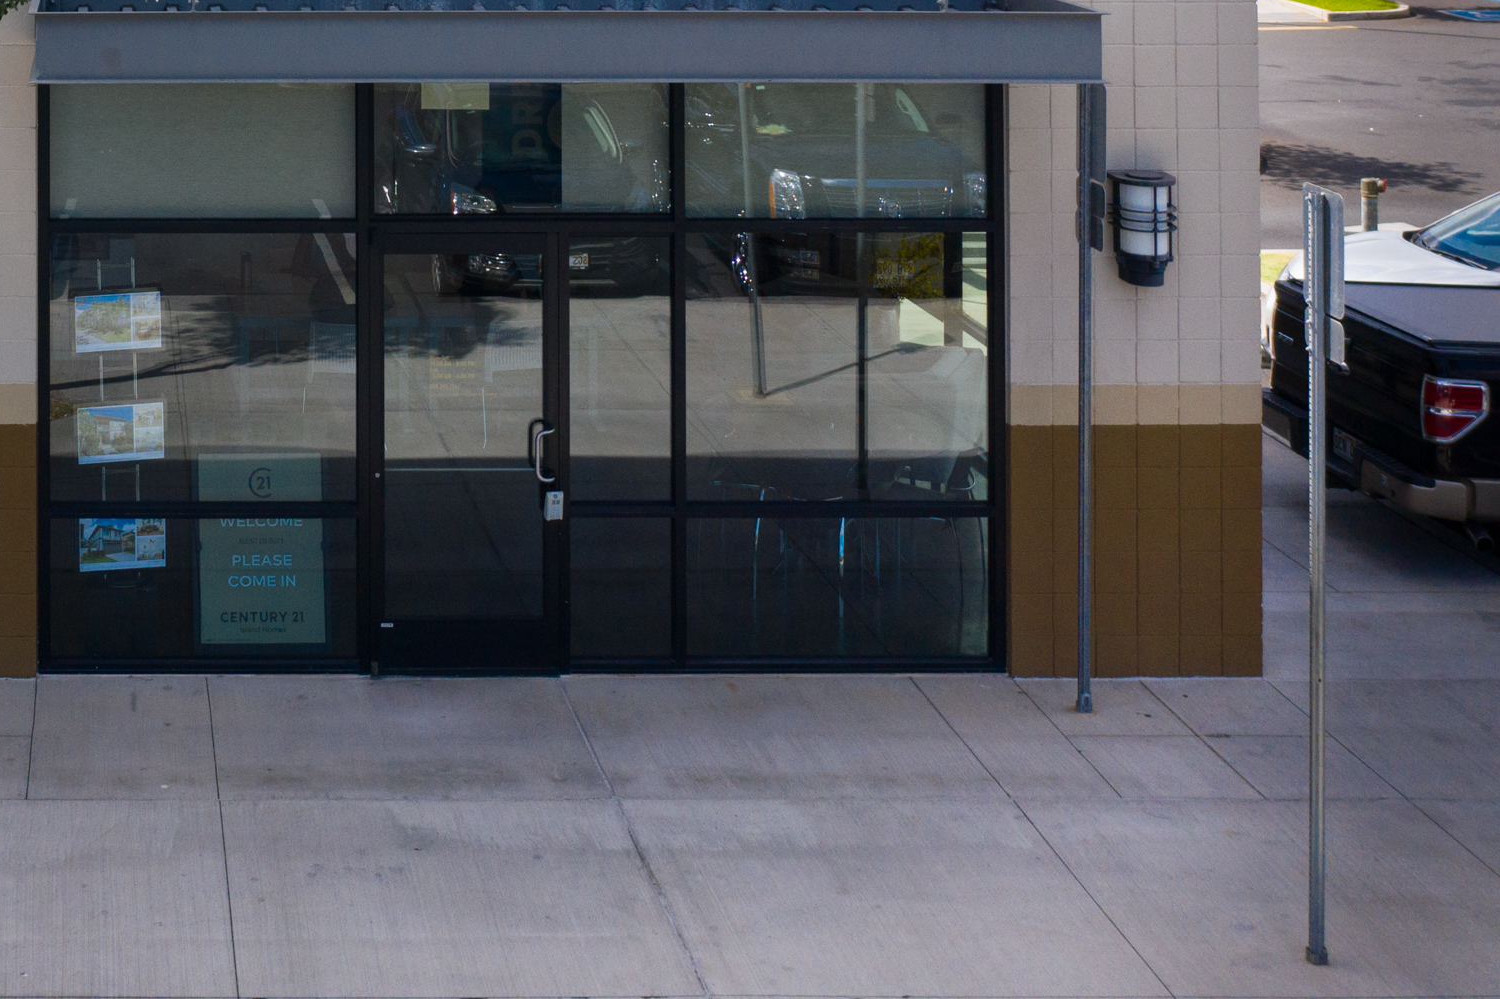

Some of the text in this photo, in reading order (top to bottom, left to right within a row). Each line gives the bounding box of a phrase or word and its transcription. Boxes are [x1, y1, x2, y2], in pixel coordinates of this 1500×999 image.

[220, 518, 303, 527] WELCOME
[232, 554, 292, 566] PLEASE
[228, 574, 296, 587] COME IN
[220, 612, 304, 623] CENTURY 21
